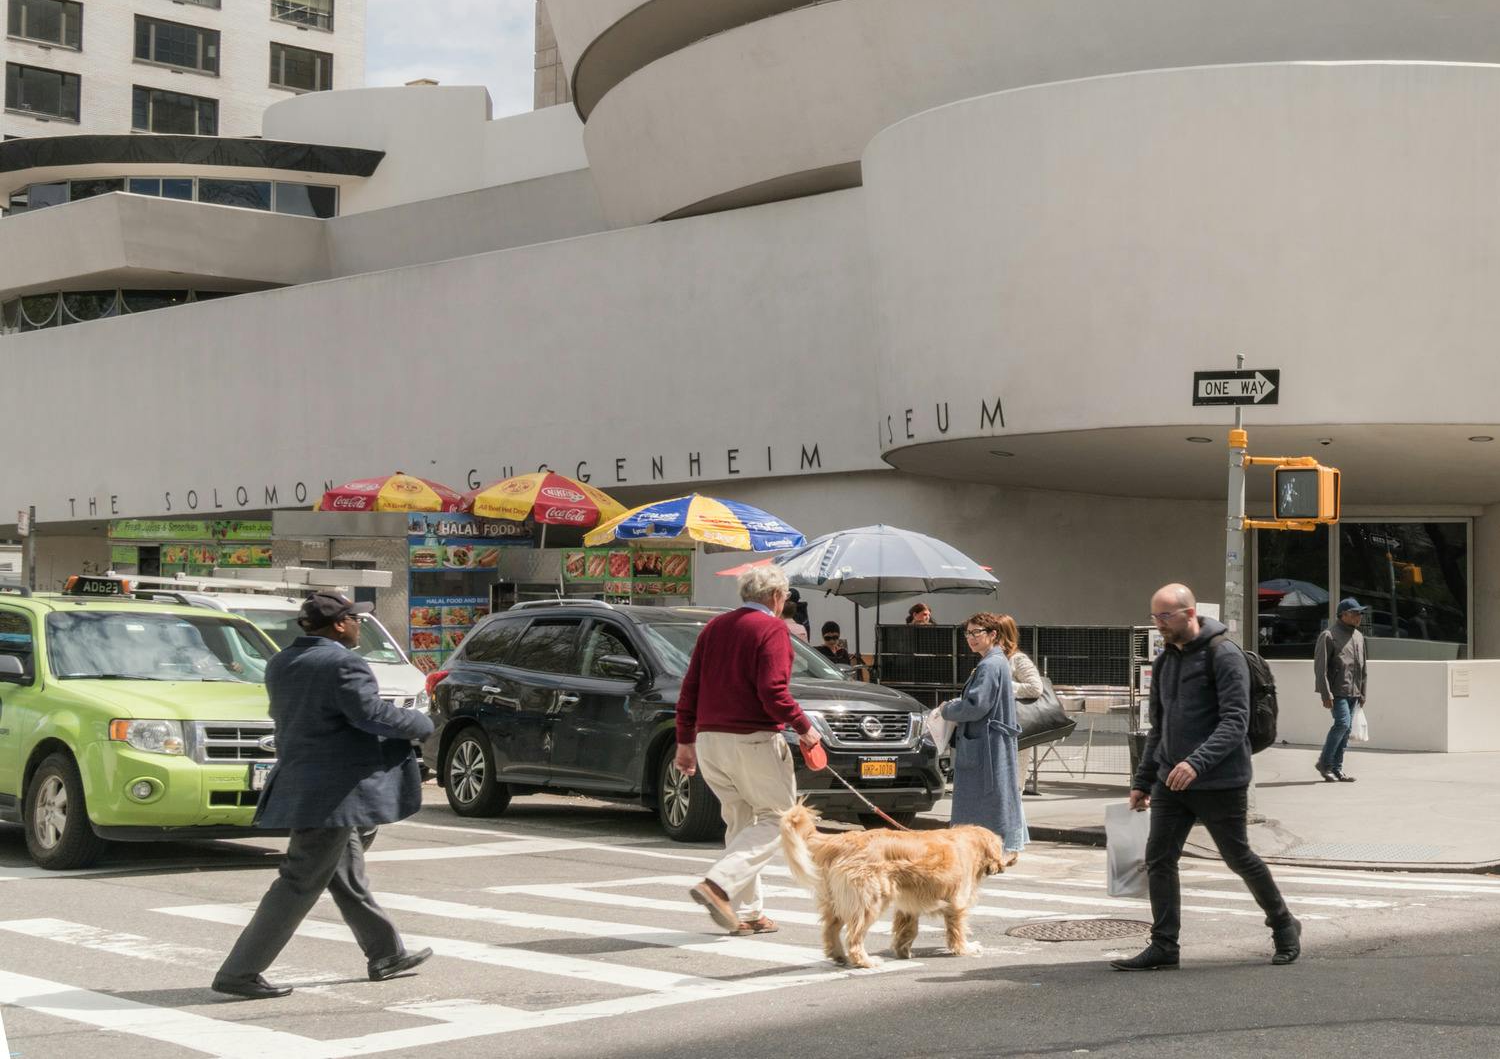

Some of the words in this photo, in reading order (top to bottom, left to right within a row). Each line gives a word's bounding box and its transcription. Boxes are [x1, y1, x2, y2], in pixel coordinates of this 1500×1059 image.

[1205, 381, 1229, 395] ONE
[1240, 381, 1266, 395] WAY
[68, 495, 119, 517] THE
[878, 397, 1005, 451] SEUM
[442, 522, 479, 535] HALAL
[484, 523, 515, 535] FOOD
